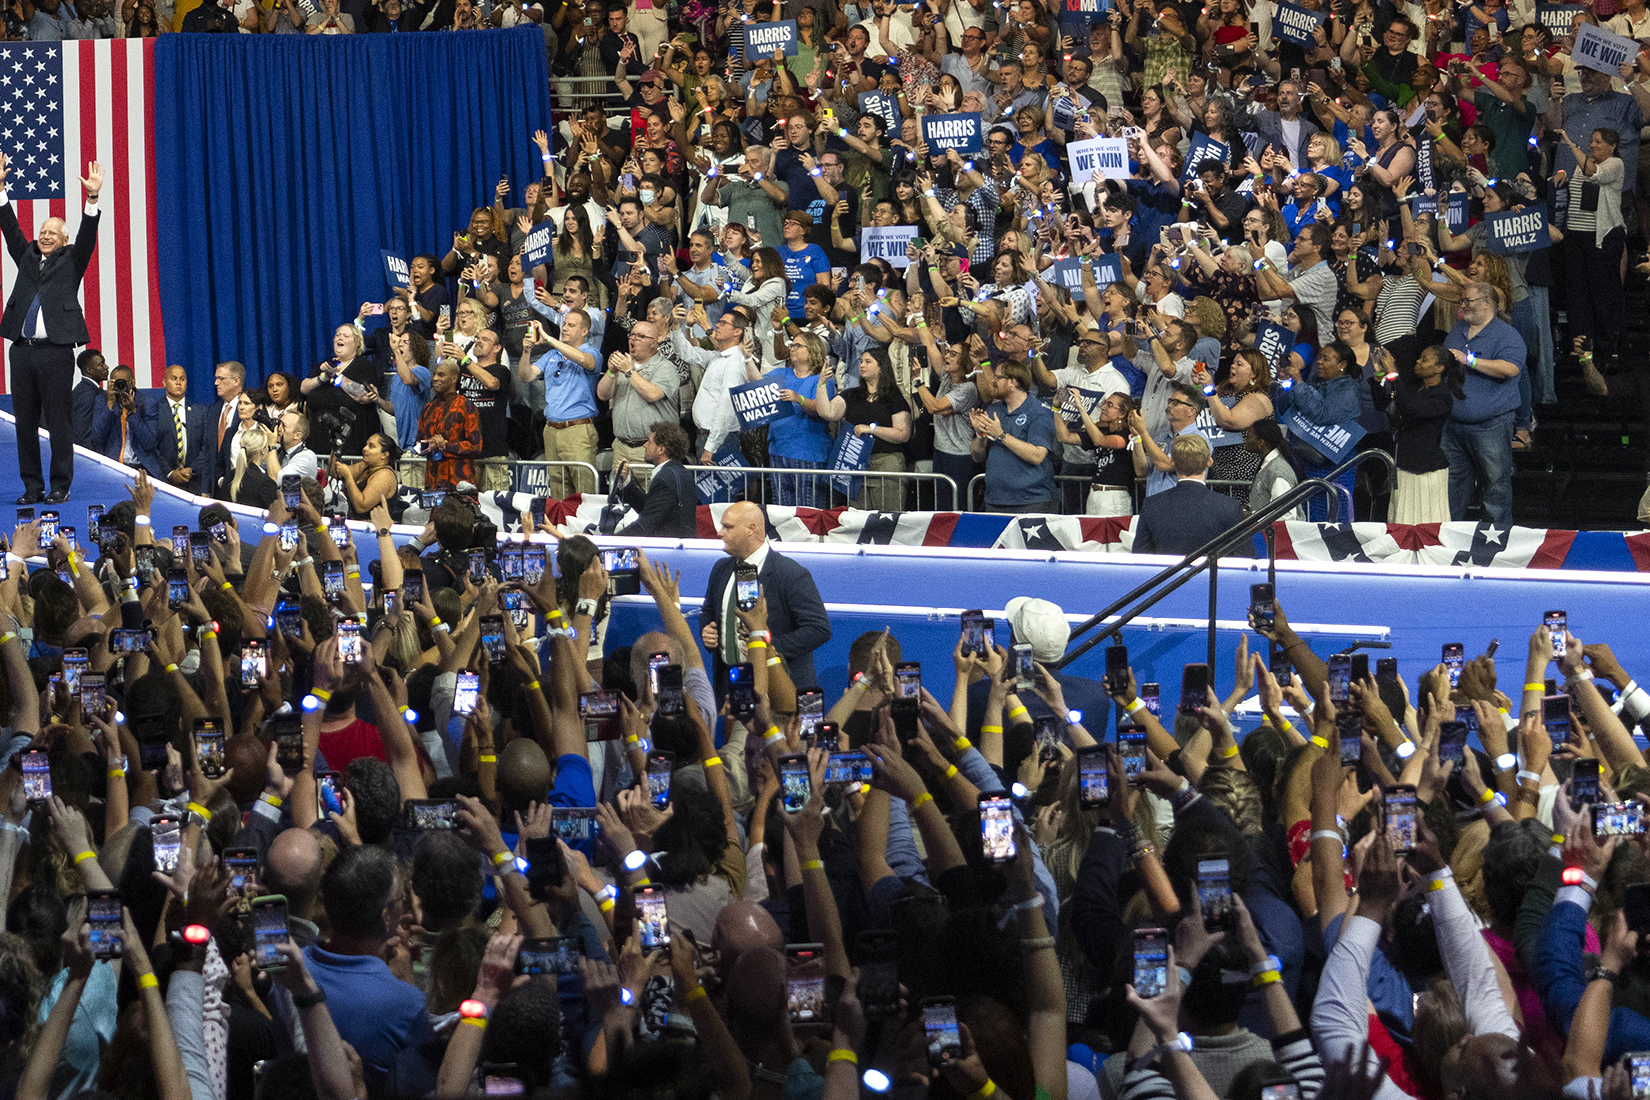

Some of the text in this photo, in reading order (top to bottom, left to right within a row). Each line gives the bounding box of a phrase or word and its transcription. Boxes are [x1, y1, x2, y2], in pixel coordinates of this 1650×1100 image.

[1279, 6, 1317, 33] HARRIS
[750, 26, 791, 45] HARRIS
[1283, 26, 1307, 41] WALZ
[757, 42, 785, 52] WALZ
[1579, 39, 1626, 67] WE WIN
[927, 120, 977, 140] HARRIS
[937, 136, 969, 149] WALZ
[1076, 152, 1123, 171] WE WIN
[1493, 212, 1543, 239] HARRIS
[1503, 231, 1538, 247] WALZ
[868, 242, 886, 258] WE
[732, 383, 781, 413] HARRIS
[742, 403, 778, 422] WALZ
